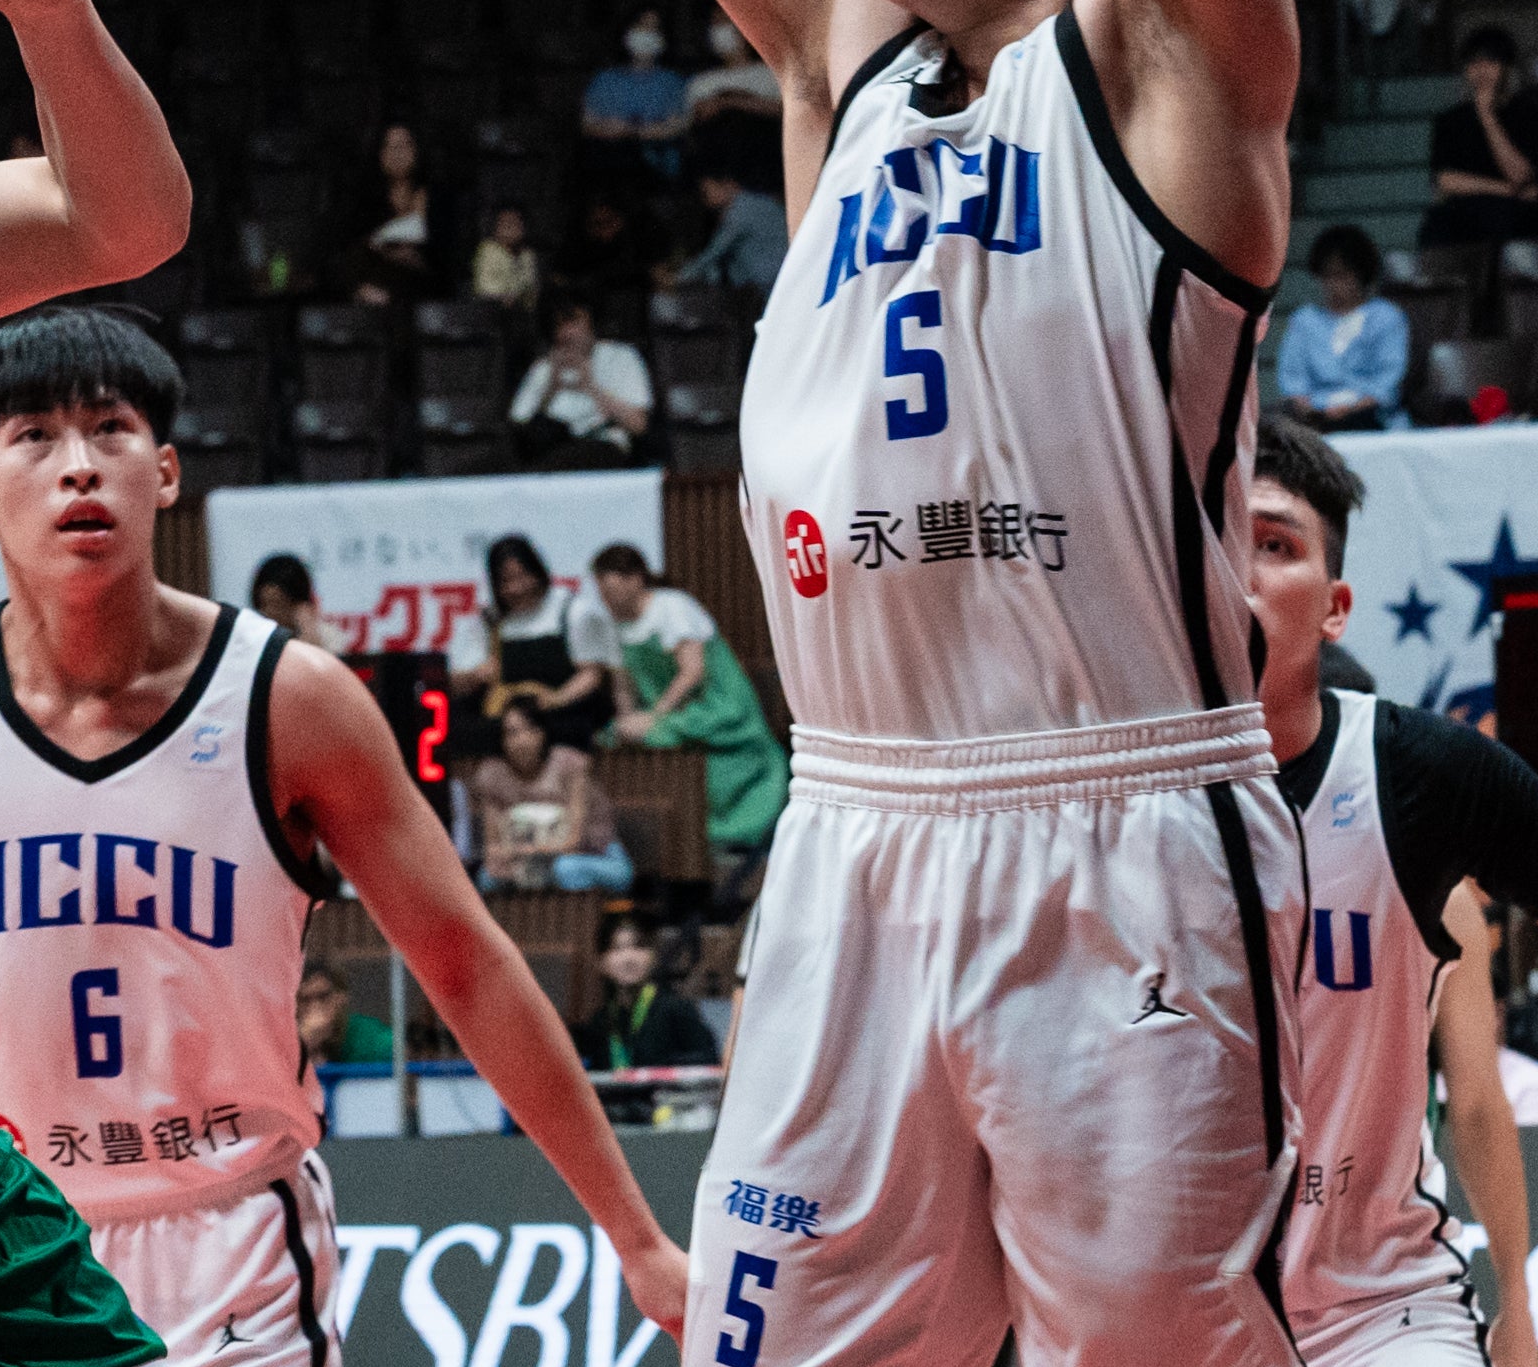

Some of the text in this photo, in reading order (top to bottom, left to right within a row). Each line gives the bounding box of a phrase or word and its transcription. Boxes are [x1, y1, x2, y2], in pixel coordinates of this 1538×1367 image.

[884, 291, 949, 441] 5
[850, 500, 1068, 571] 永豐銀行
[70, 967, 122, 1078] 6
[47, 1103, 244, 1167] 永豐銀行
[724, 1179, 823, 1239] 福樂
